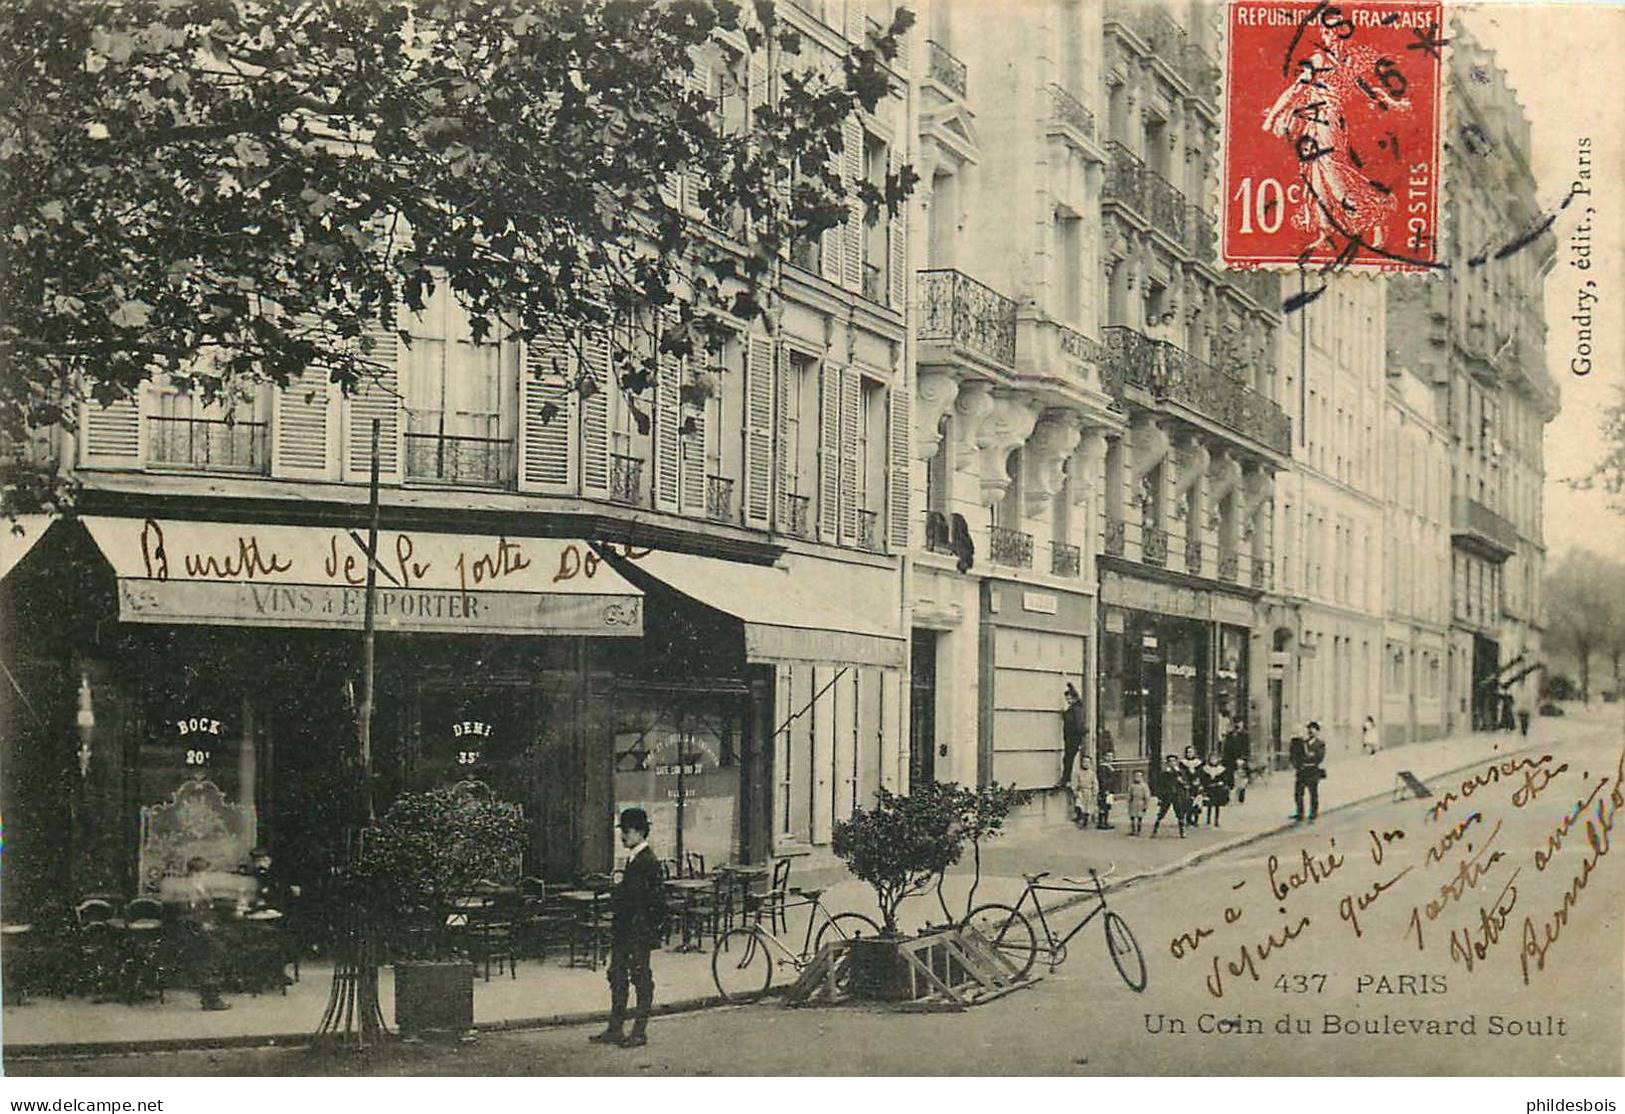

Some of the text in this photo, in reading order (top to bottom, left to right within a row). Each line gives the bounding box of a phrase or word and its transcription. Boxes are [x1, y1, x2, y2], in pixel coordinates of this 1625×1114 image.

[1407, 161, 1428, 249] POSTES
[249, 585, 314, 615] VINS
[177, 717, 221, 735] BOCK
[452, 721, 492, 737] DEMI
